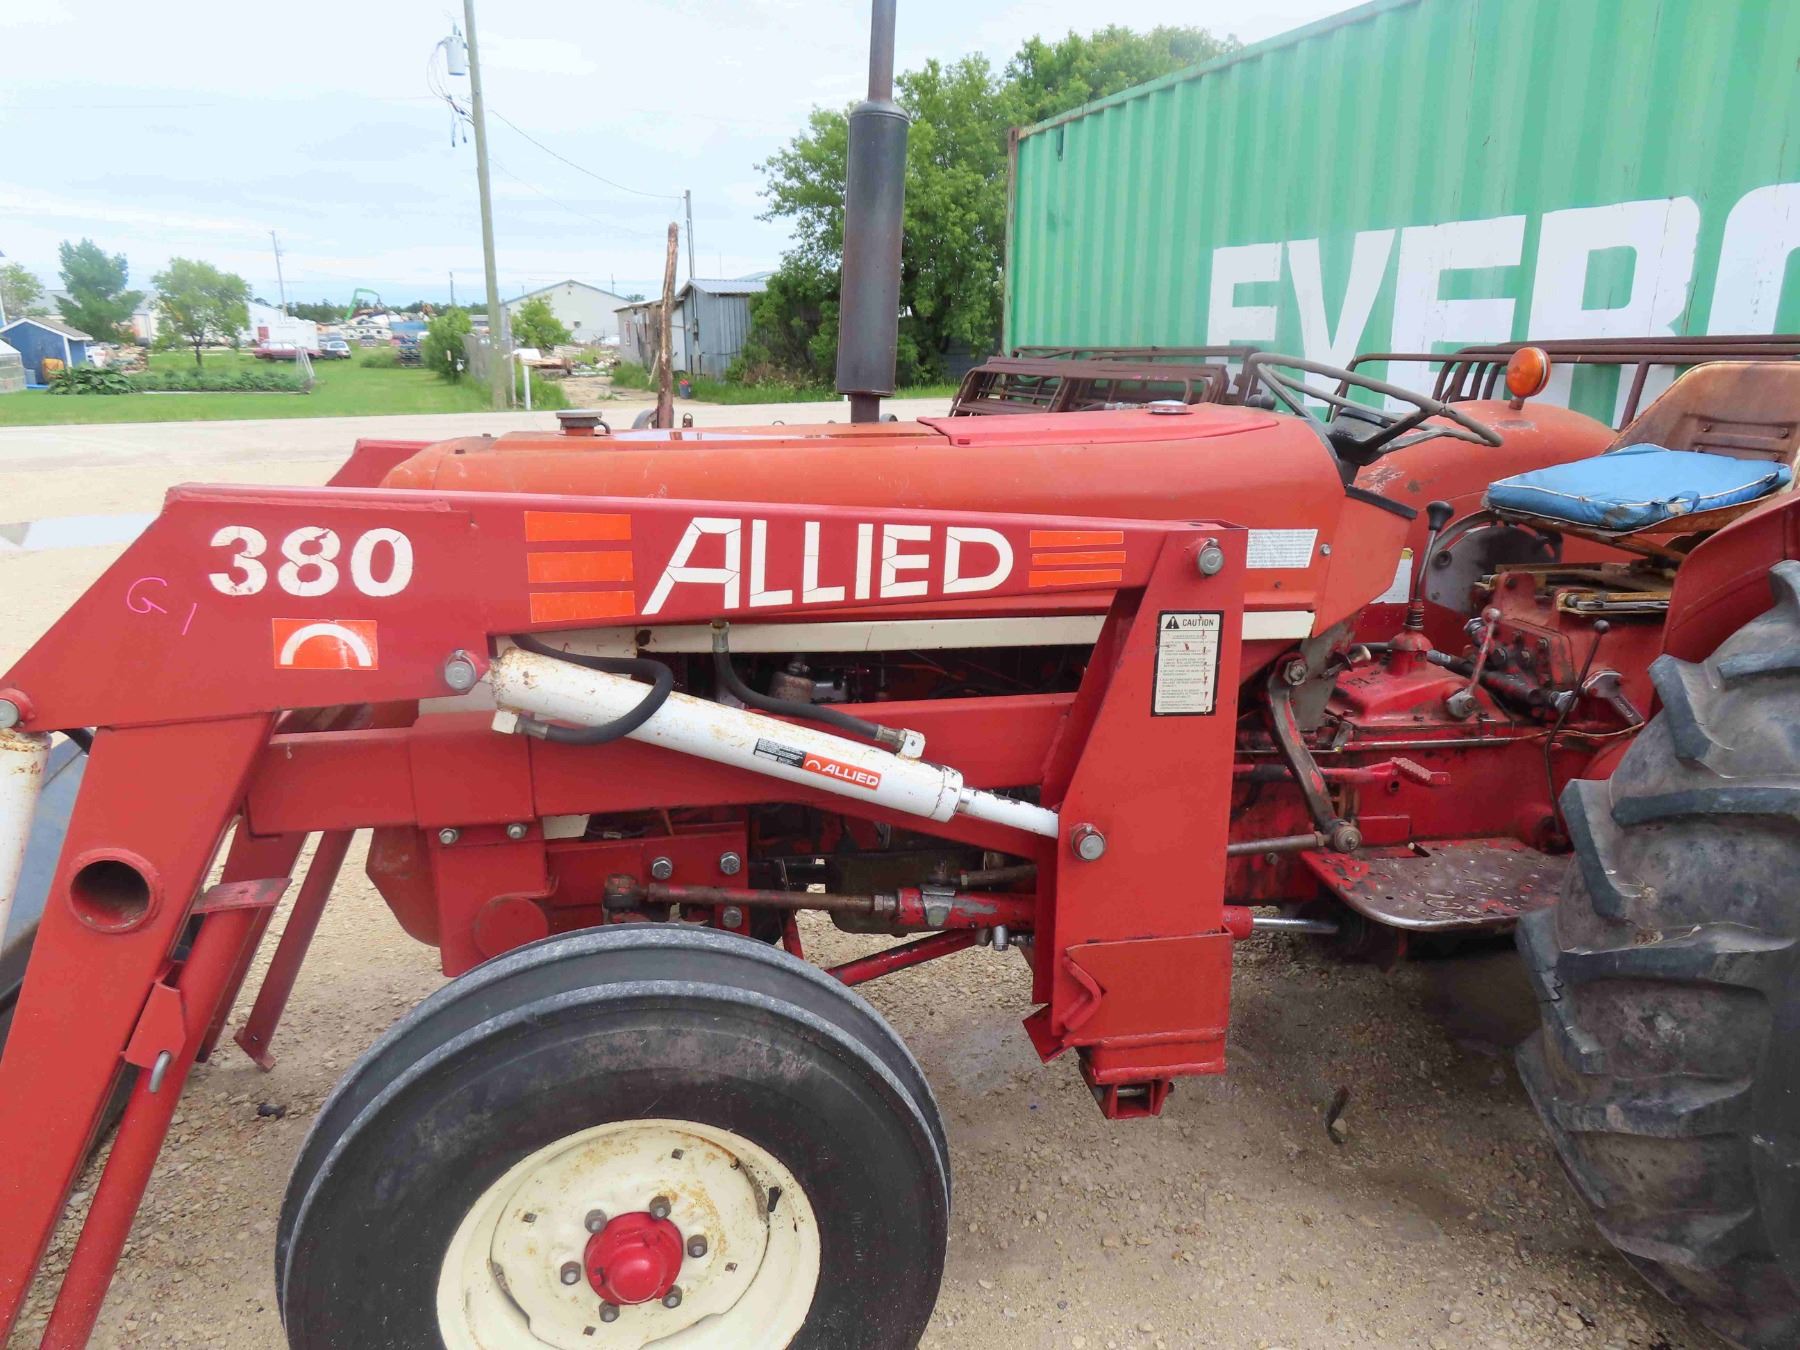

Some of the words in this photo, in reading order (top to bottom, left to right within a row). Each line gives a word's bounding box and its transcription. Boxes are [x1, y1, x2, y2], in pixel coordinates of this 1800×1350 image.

[208, 525, 414, 597] 380
[641, 517, 1014, 615] ALLIED
[1182, 618, 1215, 627] CAUTION
[821, 763, 880, 787] ALLIED
